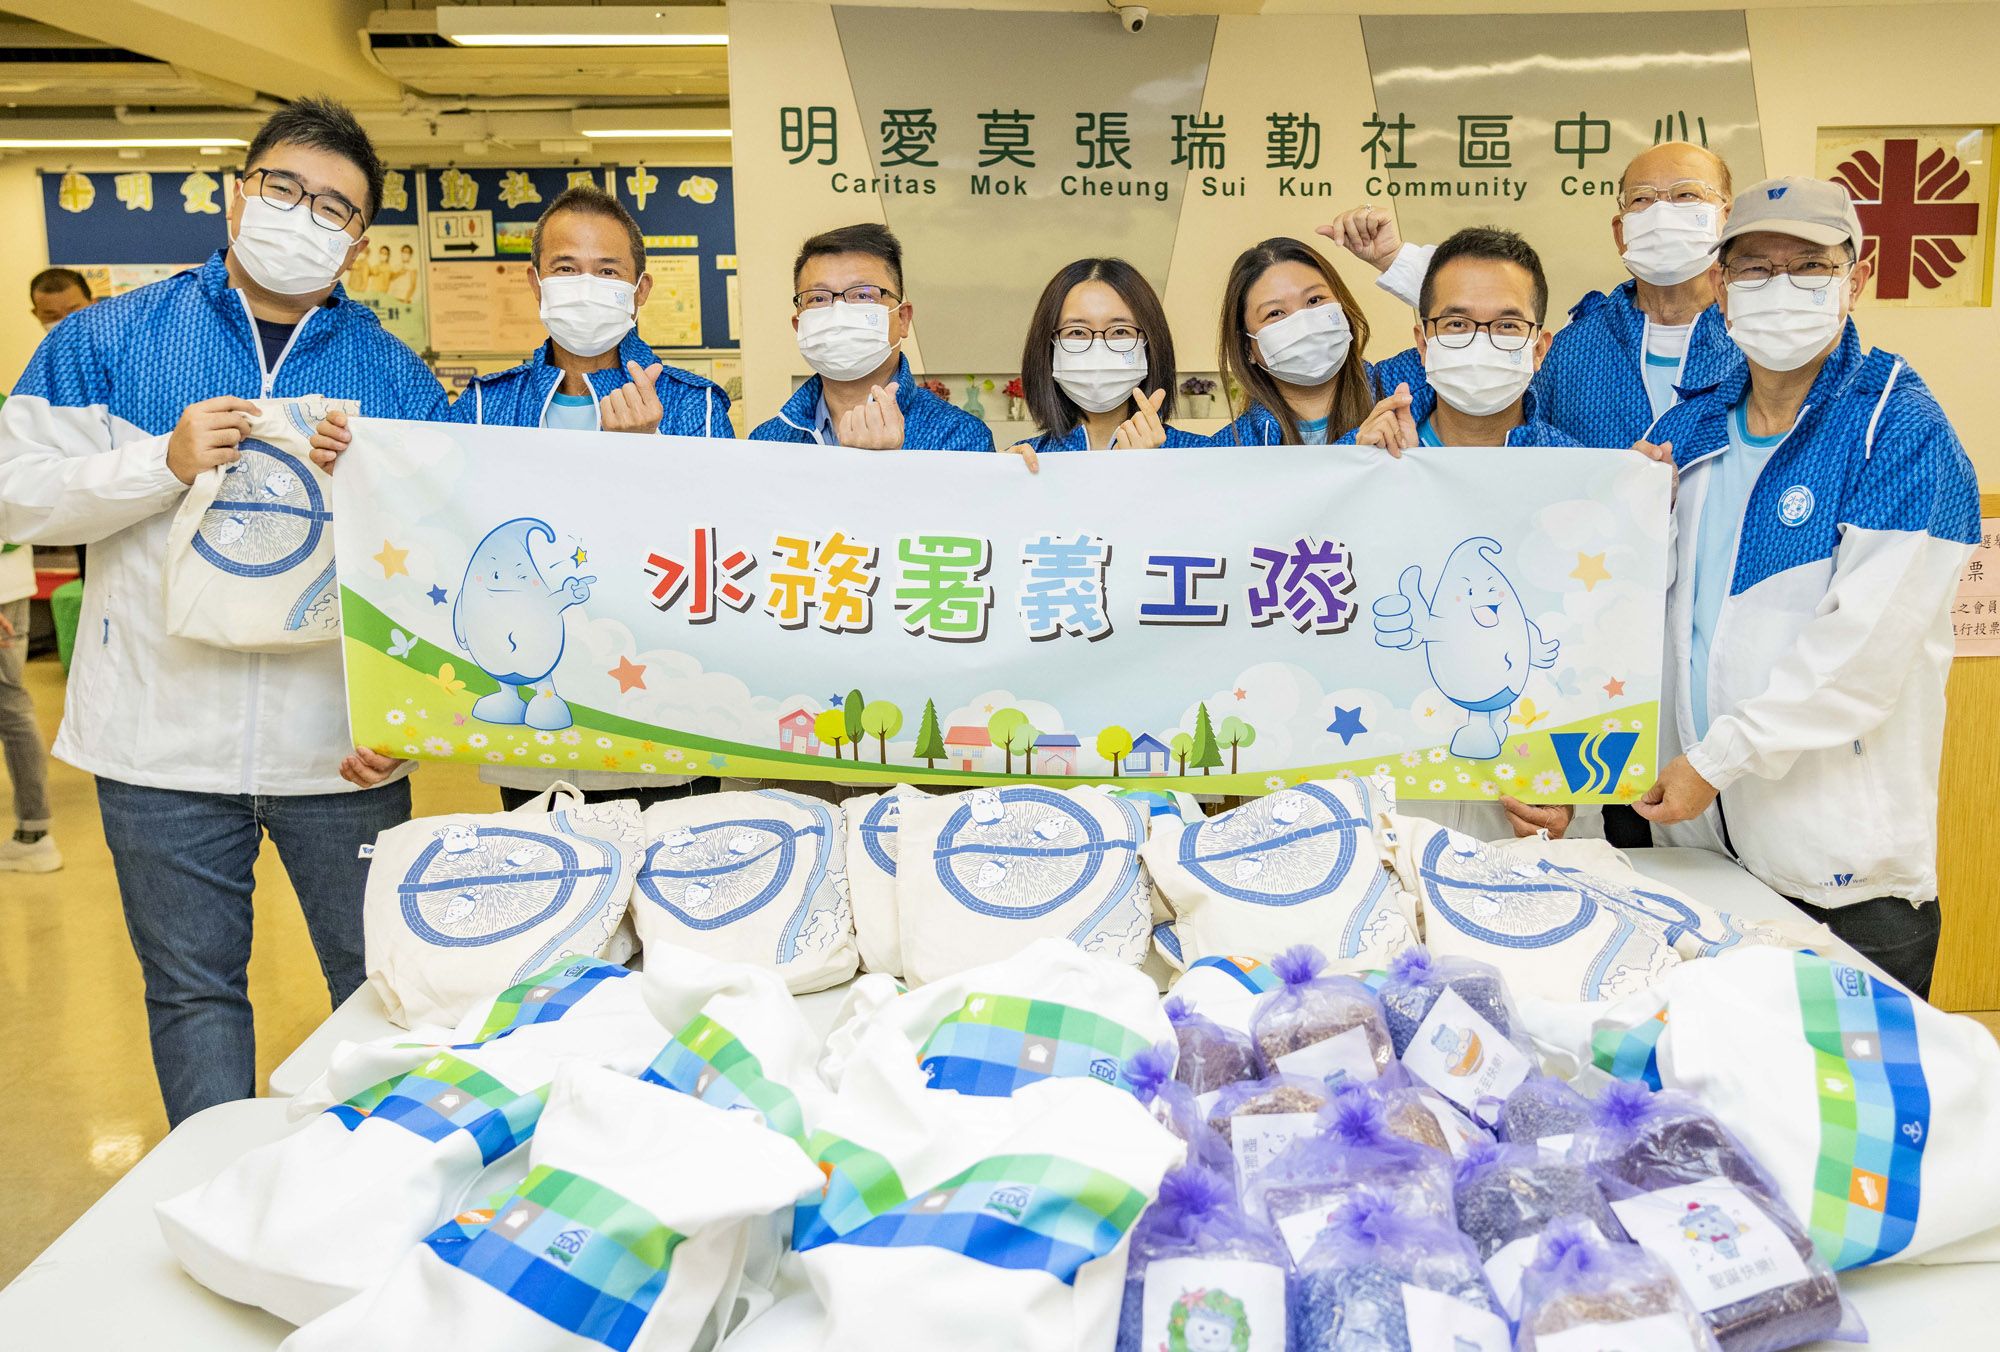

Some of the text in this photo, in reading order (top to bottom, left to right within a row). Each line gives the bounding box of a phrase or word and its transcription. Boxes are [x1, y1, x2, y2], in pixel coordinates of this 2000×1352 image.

[830, 172, 1622, 201] Caritas Mok Cheung Sui Kun Community Cen
[644, 525, 1358, 643] 水務署義工隊
[1950, 600, 1998, 615] 之會員
[1844, 966, 1859, 997] CEDD
[1089, 1061, 1117, 1081] CEDD
[989, 1190, 1028, 1209] CEDD
[552, 1235, 581, 1255] CEDD
